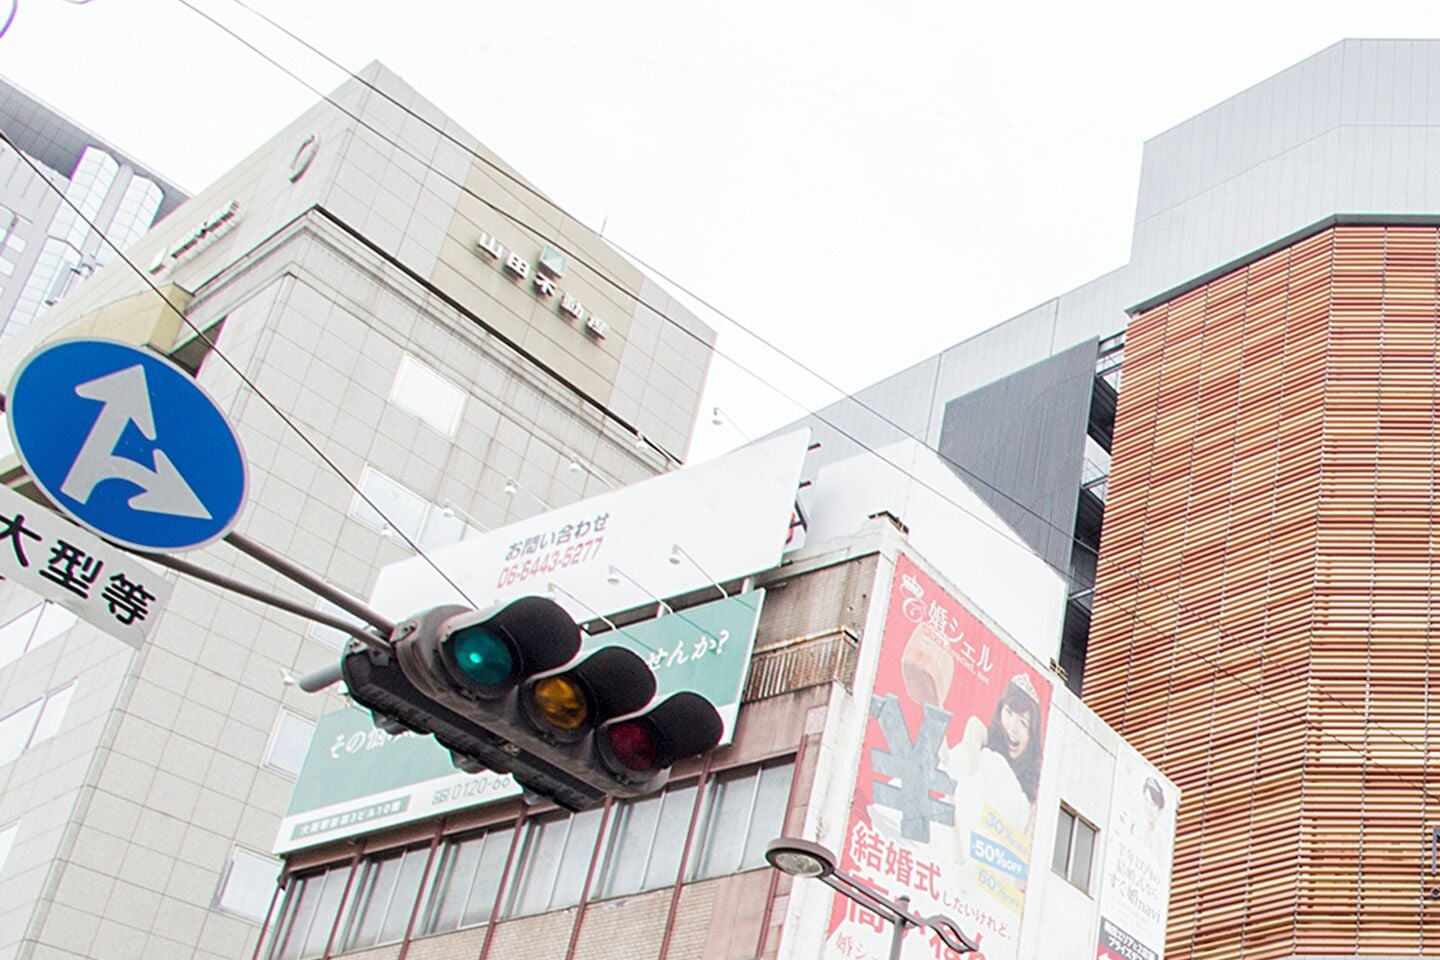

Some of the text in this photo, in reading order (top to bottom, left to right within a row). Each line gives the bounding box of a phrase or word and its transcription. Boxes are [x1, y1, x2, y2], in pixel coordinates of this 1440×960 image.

[0, 513, 157, 625] 大型等
[497, 537, 604, 589] 06-6443-5277
[505, 512, 610, 561] お問い合わせ
[928, 600, 993, 673] 婚シェル
[853, 825, 941, 901] 結婚式
